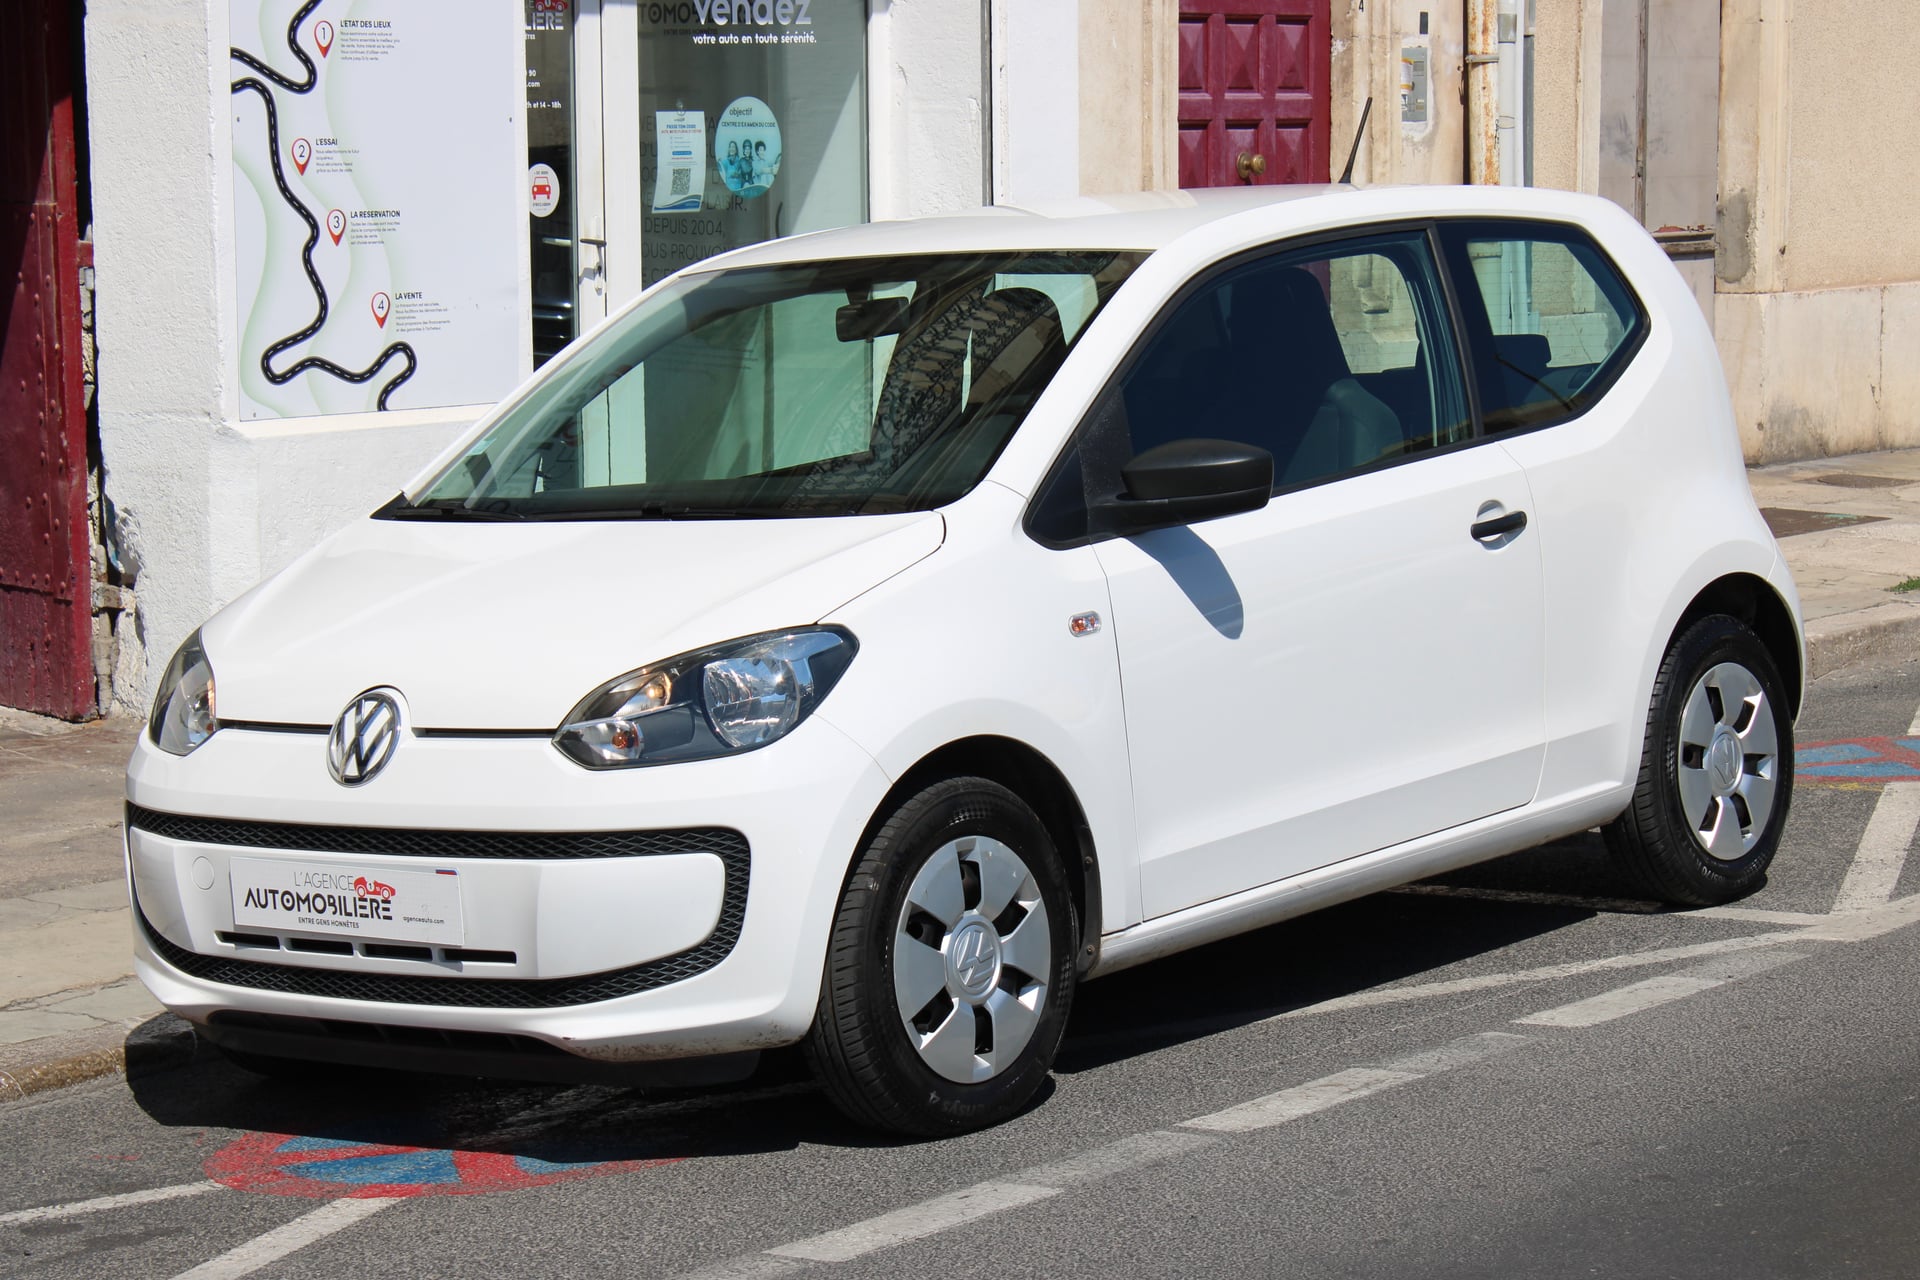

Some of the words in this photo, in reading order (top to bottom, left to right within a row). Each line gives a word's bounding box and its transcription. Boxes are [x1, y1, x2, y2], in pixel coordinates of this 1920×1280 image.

[693, 0, 812, 26] vendez
[340, 20, 359, 28] L'ETAT
[360, 20, 373, 28] DES
[373, 20, 392, 29] LIEUX
[693, 33, 716, 45] votre
[718, 33, 739, 44] auto
[741, 35, 752, 44] en
[755, 32, 779, 44] toute
[780, 30, 817, 43] sérénité.
[729, 107, 752, 118] objectif
[315, 138, 338, 146] L'ESSAI
[298, 144, 306, 158] 2
[350, 211, 359, 219] LA
[359, 209, 401, 219] RESERVATION
[333, 215, 340, 229] 3
[644, 217, 688, 234] DEPUIS
[691, 220, 726, 239] 2004,
[395, 292, 403, 300] LA
[403, 291, 423, 300] VENTE
[377, 299, 385, 311] 4
[294, 871, 355, 892] L'AGENCE
[244, 887, 393, 921] AUTOMOBILIERE
[298, 916, 315, 925] ENTRE
[316, 917, 330, 926] GENS
[331, 918, 360, 929] HONNÊTES
